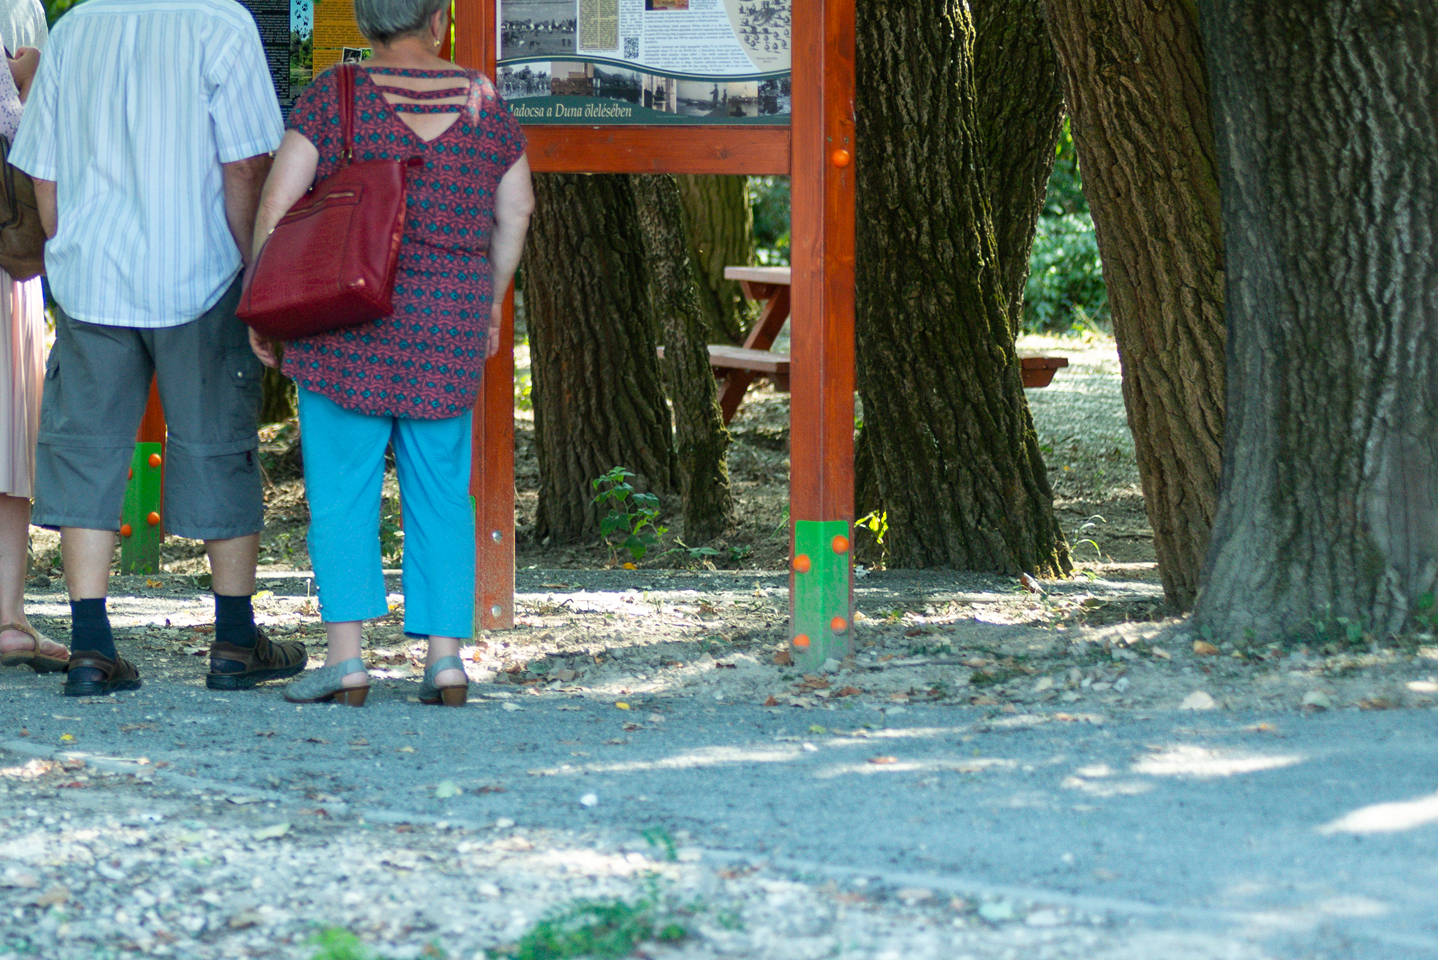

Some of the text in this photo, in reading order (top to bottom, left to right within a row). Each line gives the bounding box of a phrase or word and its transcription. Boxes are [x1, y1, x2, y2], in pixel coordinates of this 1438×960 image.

[546, 107, 553, 118] a
[555, 103, 583, 118] Duna
[584, 103, 632, 118] ölelésében
